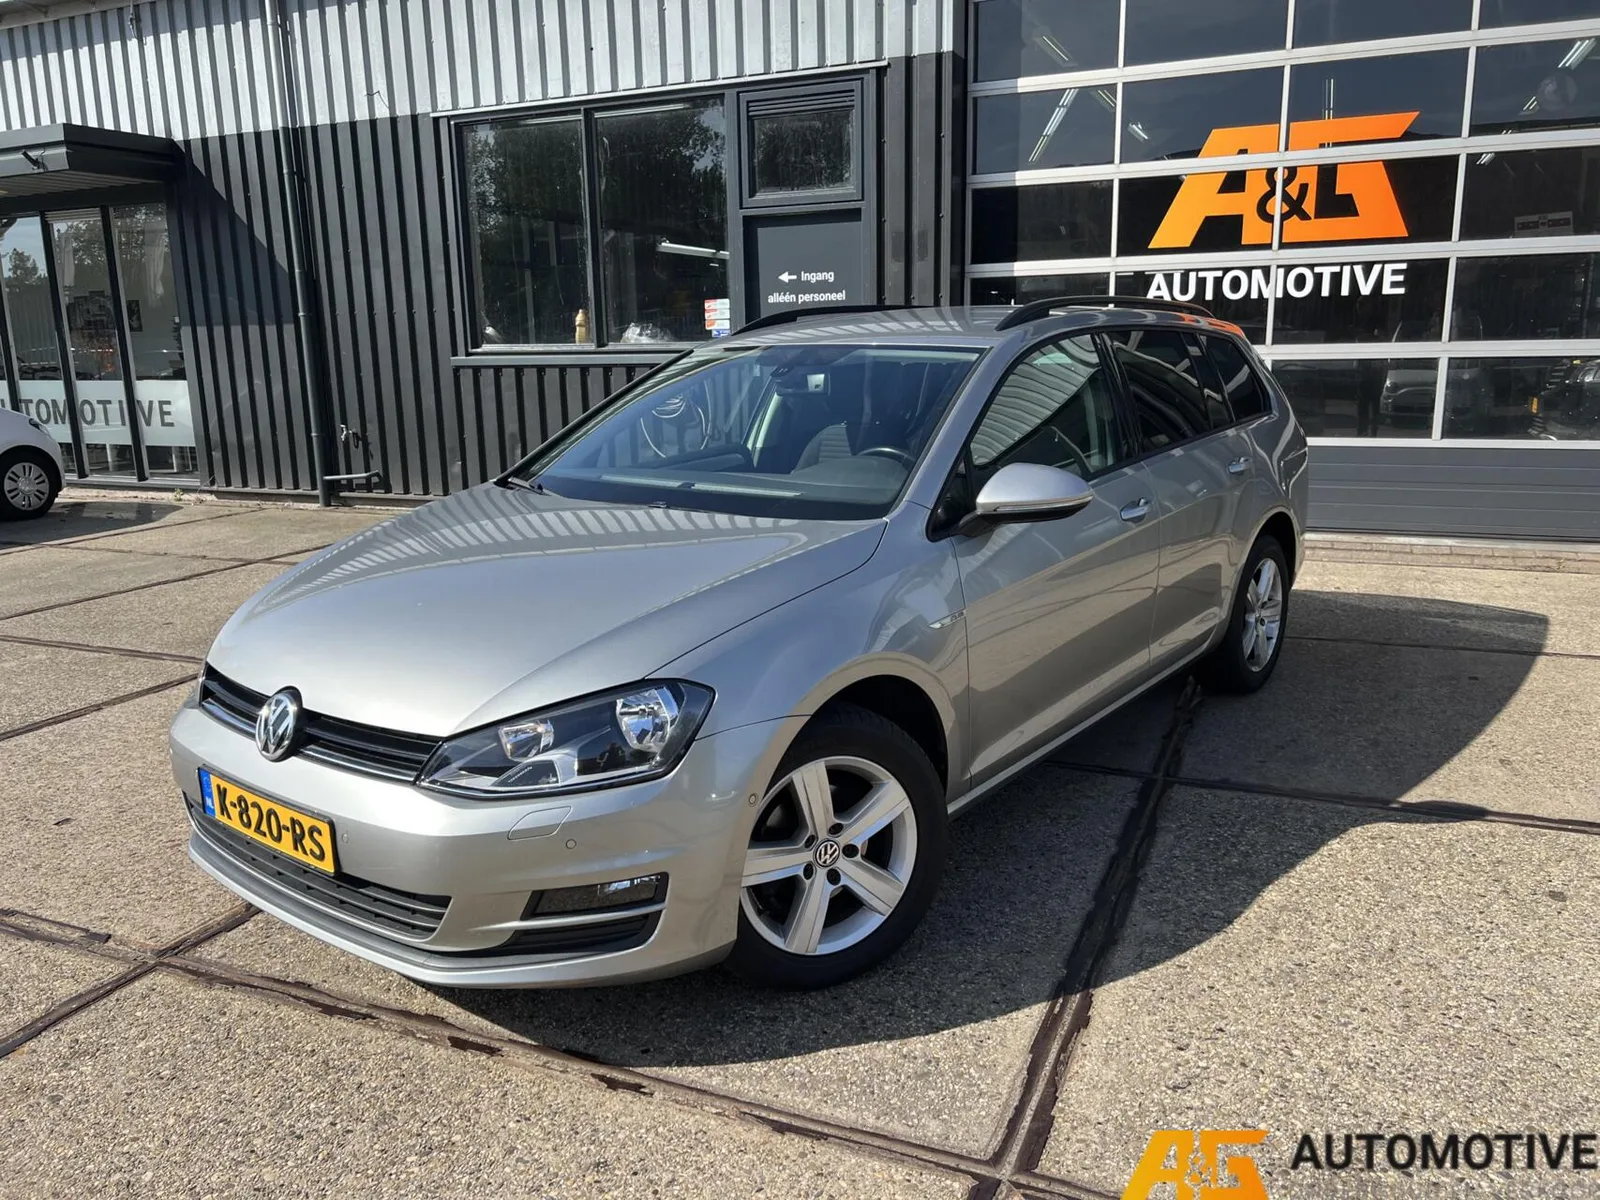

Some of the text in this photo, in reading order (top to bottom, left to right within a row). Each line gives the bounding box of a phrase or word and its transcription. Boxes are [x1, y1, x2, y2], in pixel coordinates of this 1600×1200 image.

[801, 271, 835, 283] Ingang
[1145, 263, 1408, 302] AUTOMOTIVE
[767, 290, 846, 304] alléén personeel
[0, 398, 175, 427] TOMOTIVE
[216, 783, 326, 862] K-820-RS
